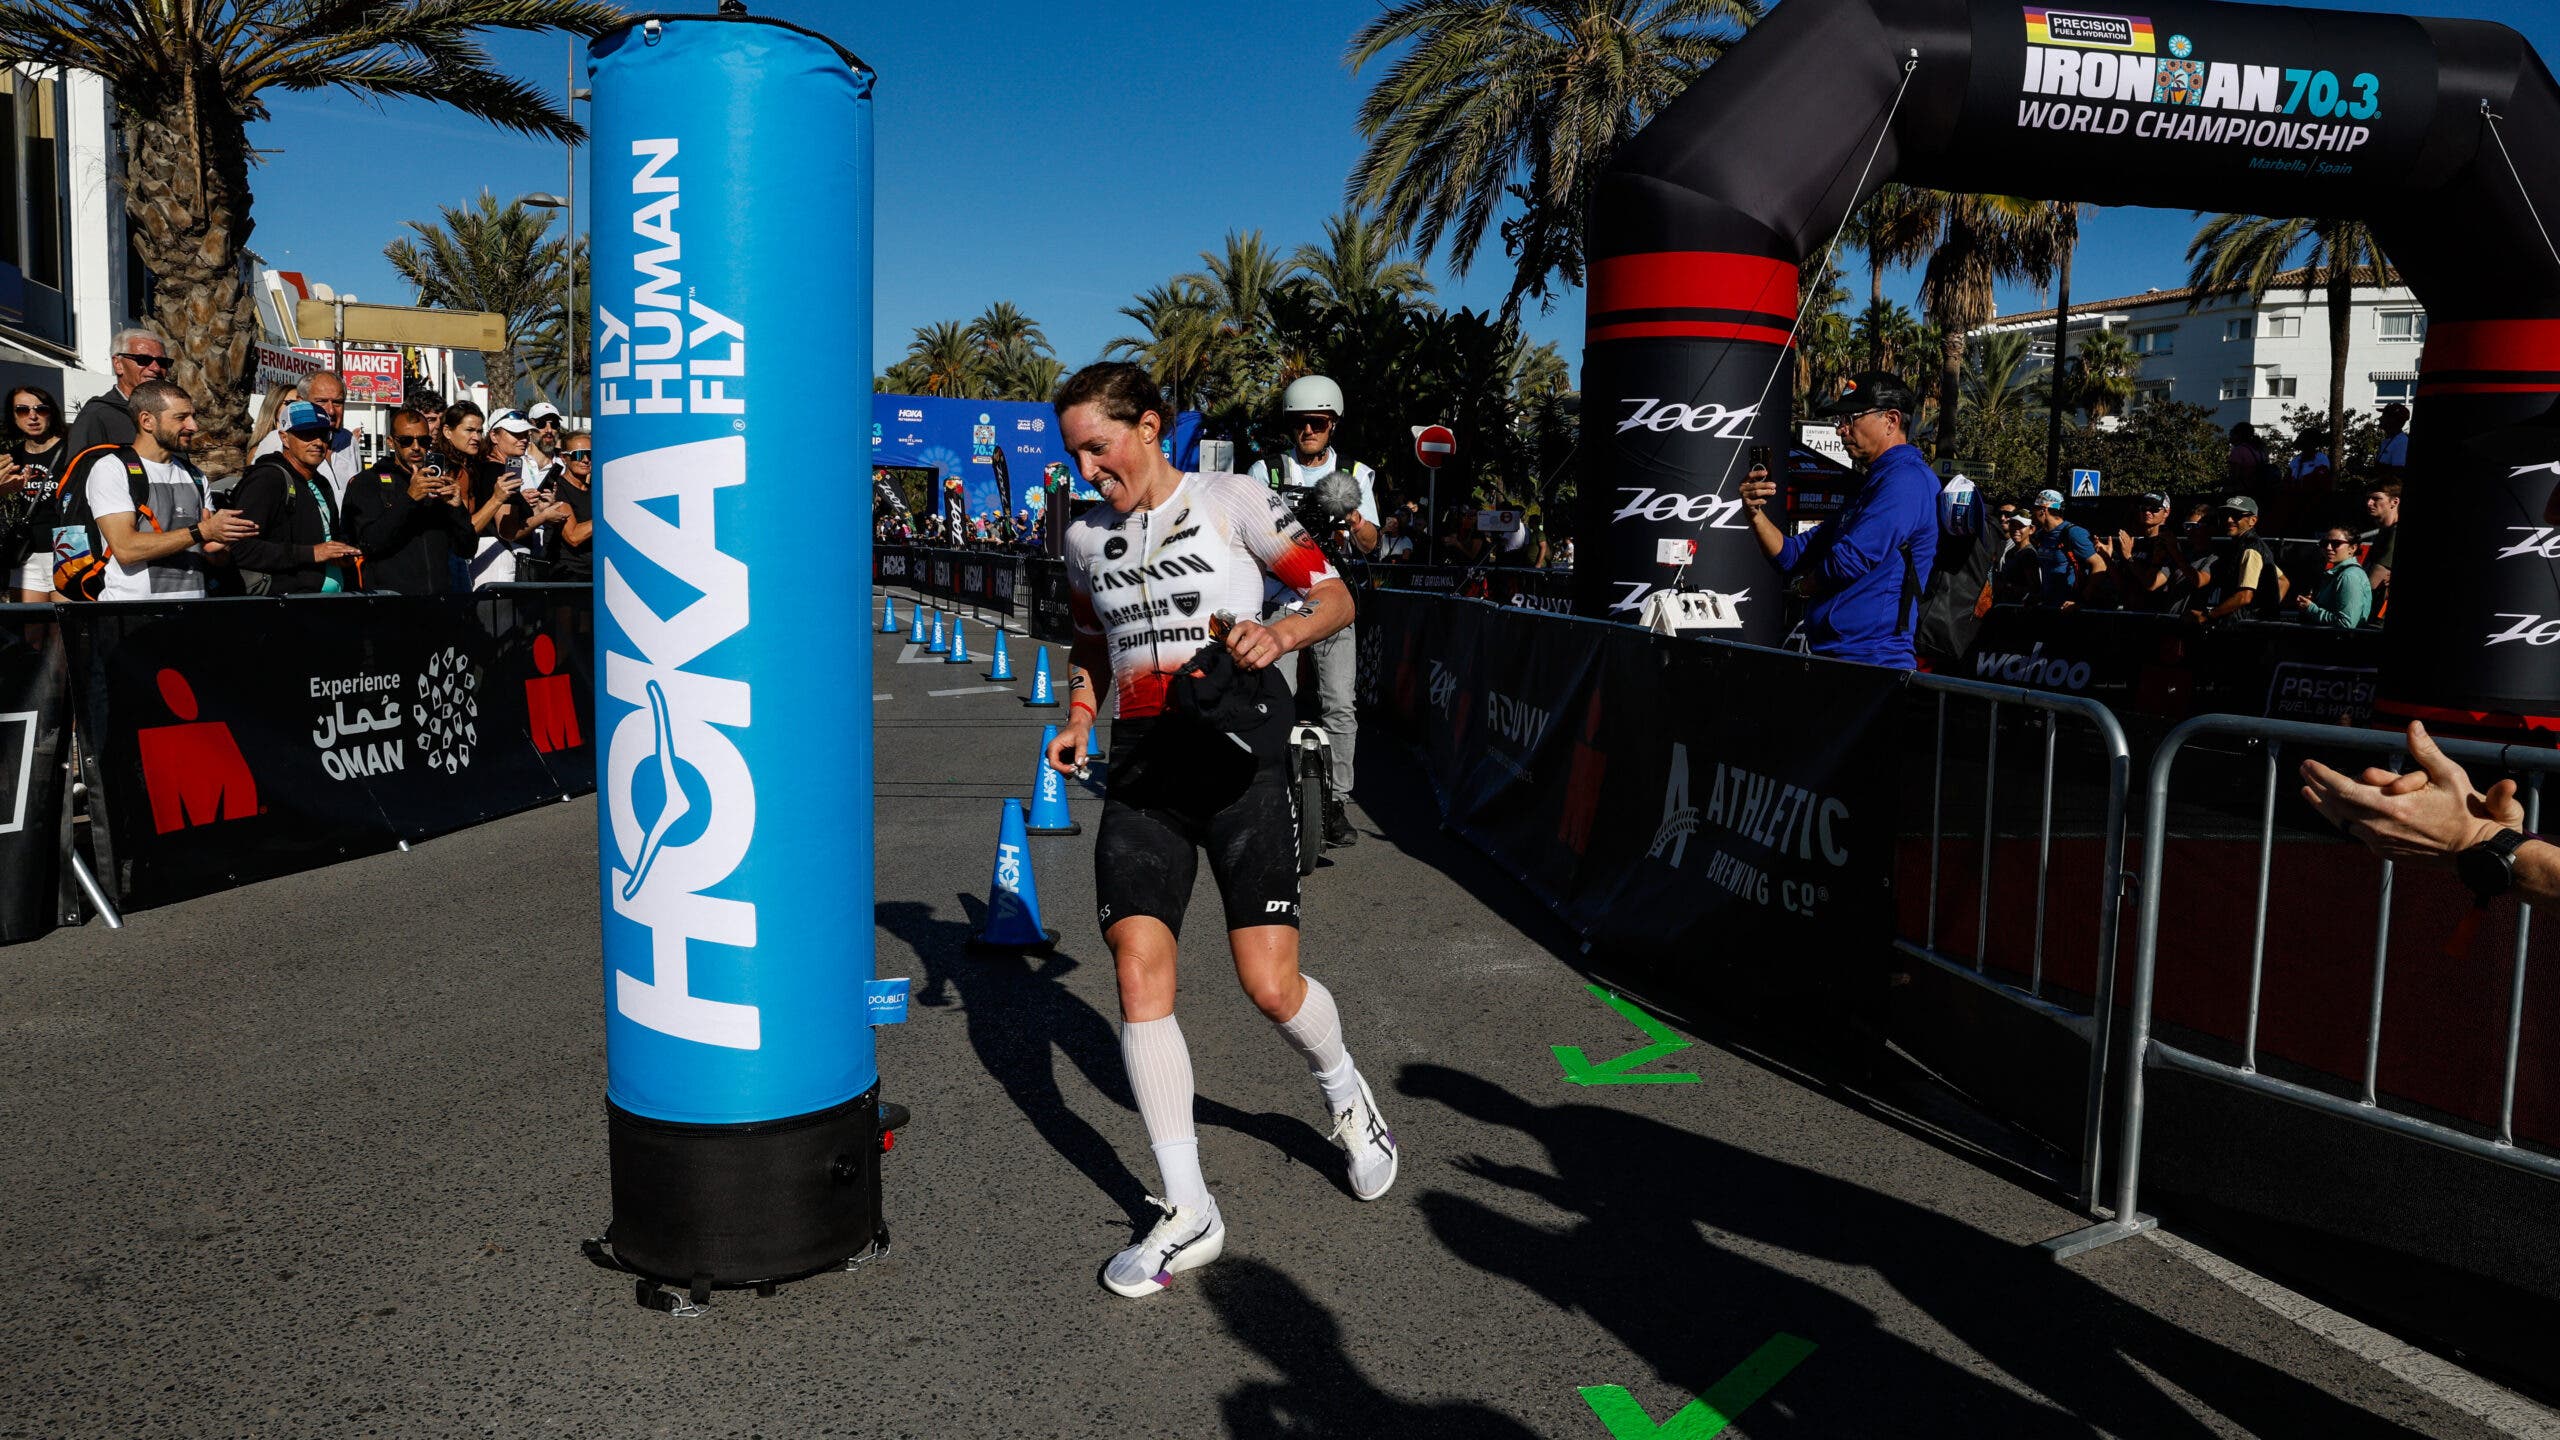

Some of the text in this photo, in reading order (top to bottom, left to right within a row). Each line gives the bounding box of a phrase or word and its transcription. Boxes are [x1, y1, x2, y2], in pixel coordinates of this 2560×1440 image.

[2053, 17, 2126, 33] PRECISION
[2055, 28, 2075, 36] FUEL
[2082, 30, 2127, 40] HYDRATION
[2282, 69, 2379, 119] 70.3
[2018, 100, 2370, 152] WORLD CHAMPIONSHIP
[2249, 157, 2352, 175] Marbella Spain
[632, 138, 683, 414] HUMAN
[299, 351, 397, 373] EMARKET
[600, 304, 630, 415] FLY
[689, 299, 744, 414] FLY
[898, 410, 922, 418] HOKA
[1161, 525, 1200, 547] RAW
[1091, 553, 1215, 593] CANYON
[1104, 598, 1168, 620] BAHRAIN
[1111, 608, 1169, 627] VICTORIOUS
[1118, 626, 1205, 652] SHIMANO
[1037, 671, 1046, 699] HOKA
[1976, 641, 2092, 689] wahoo
[310, 672, 400, 700] Experience
[1488, 690, 1549, 751] ROUVY
[321, 739, 405, 780] OMAN
[602, 435, 761, 1050] HOKA
[1707, 762, 1849, 867] ATHLETIC
[998, 843, 1020, 919] HOKA
[1706, 850, 1769, 906] BREWING
[1265, 900, 1290, 912] DT
